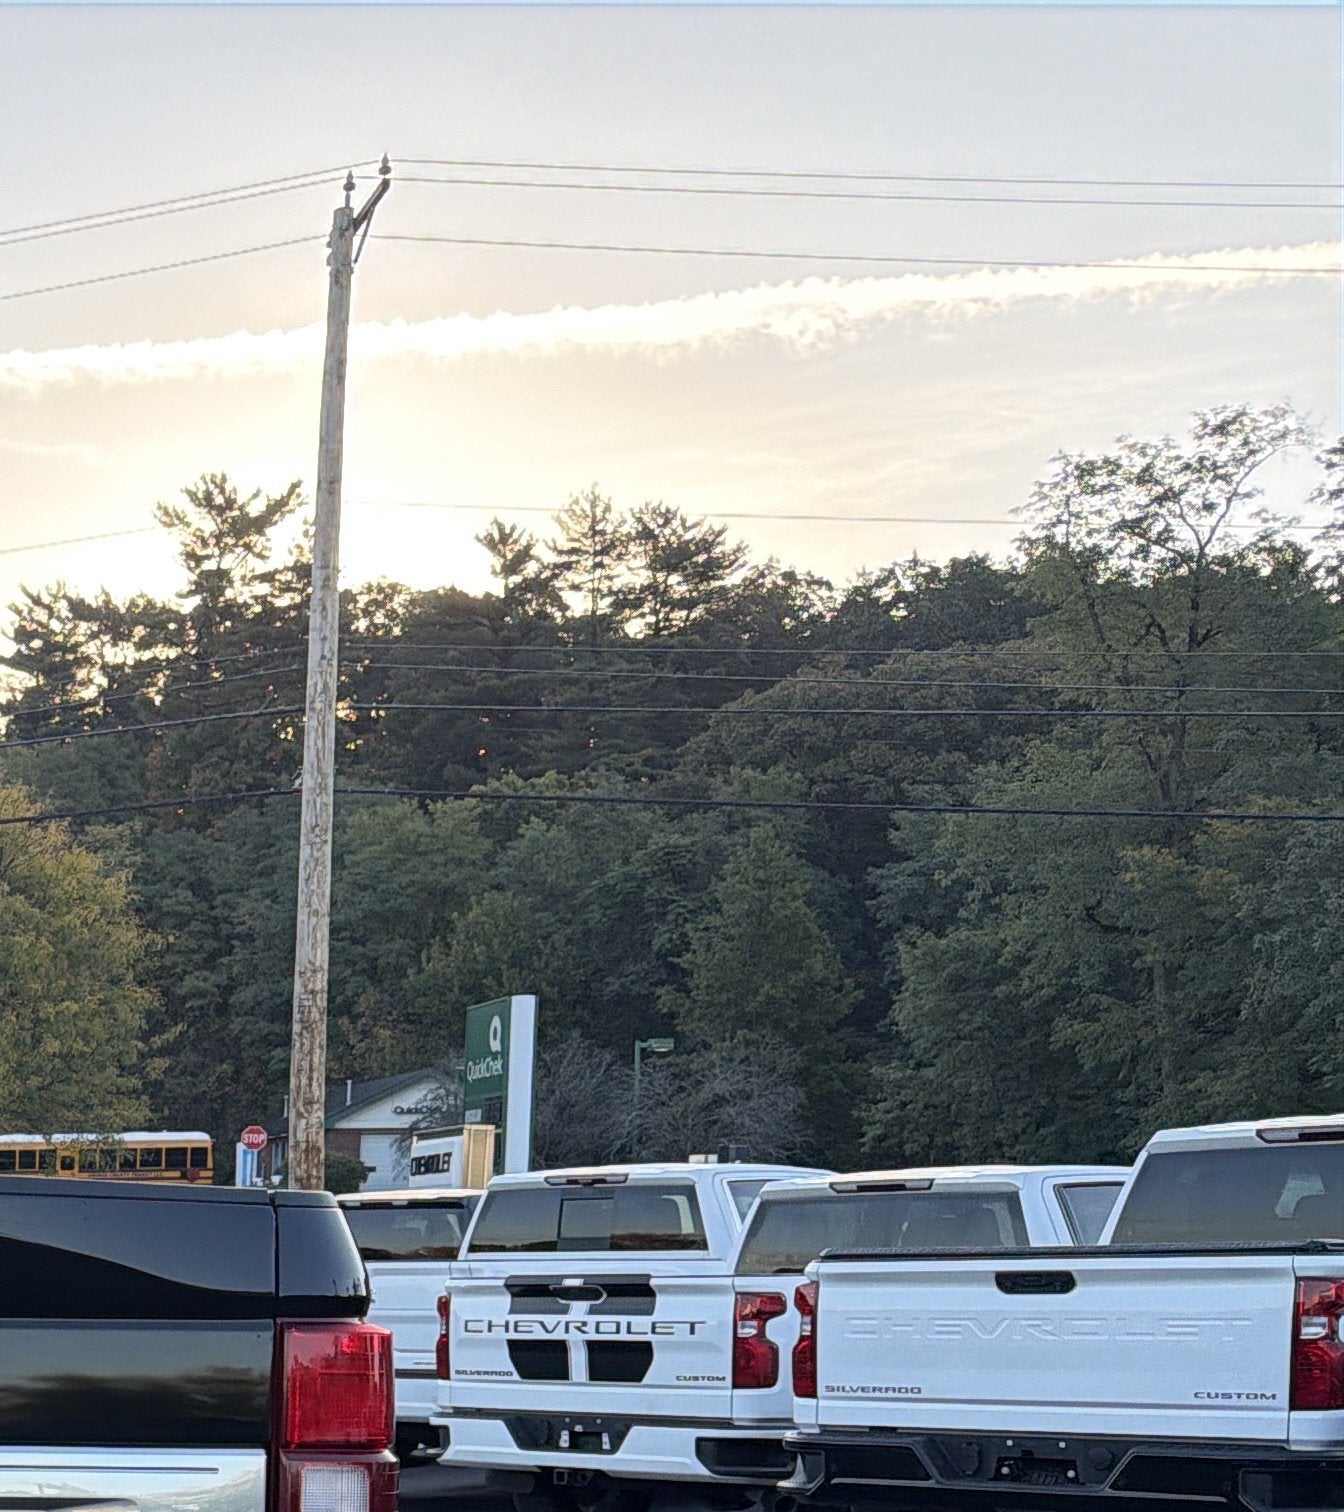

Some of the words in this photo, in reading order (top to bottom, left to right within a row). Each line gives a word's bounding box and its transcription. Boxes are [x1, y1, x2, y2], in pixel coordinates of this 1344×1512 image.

[467, 1055, 504, 1083] QuickChek
[243, 1133, 265, 1144] STOP
[464, 1319, 707, 1336] CHEVROLET
[843, 1316, 1253, 1342] CHEVROLET
[454, 1369, 514, 1377] SILVERADO
[824, 1384, 922, 1395] SILVERADO
[1193, 1391, 1277, 1401] CUSTOM
